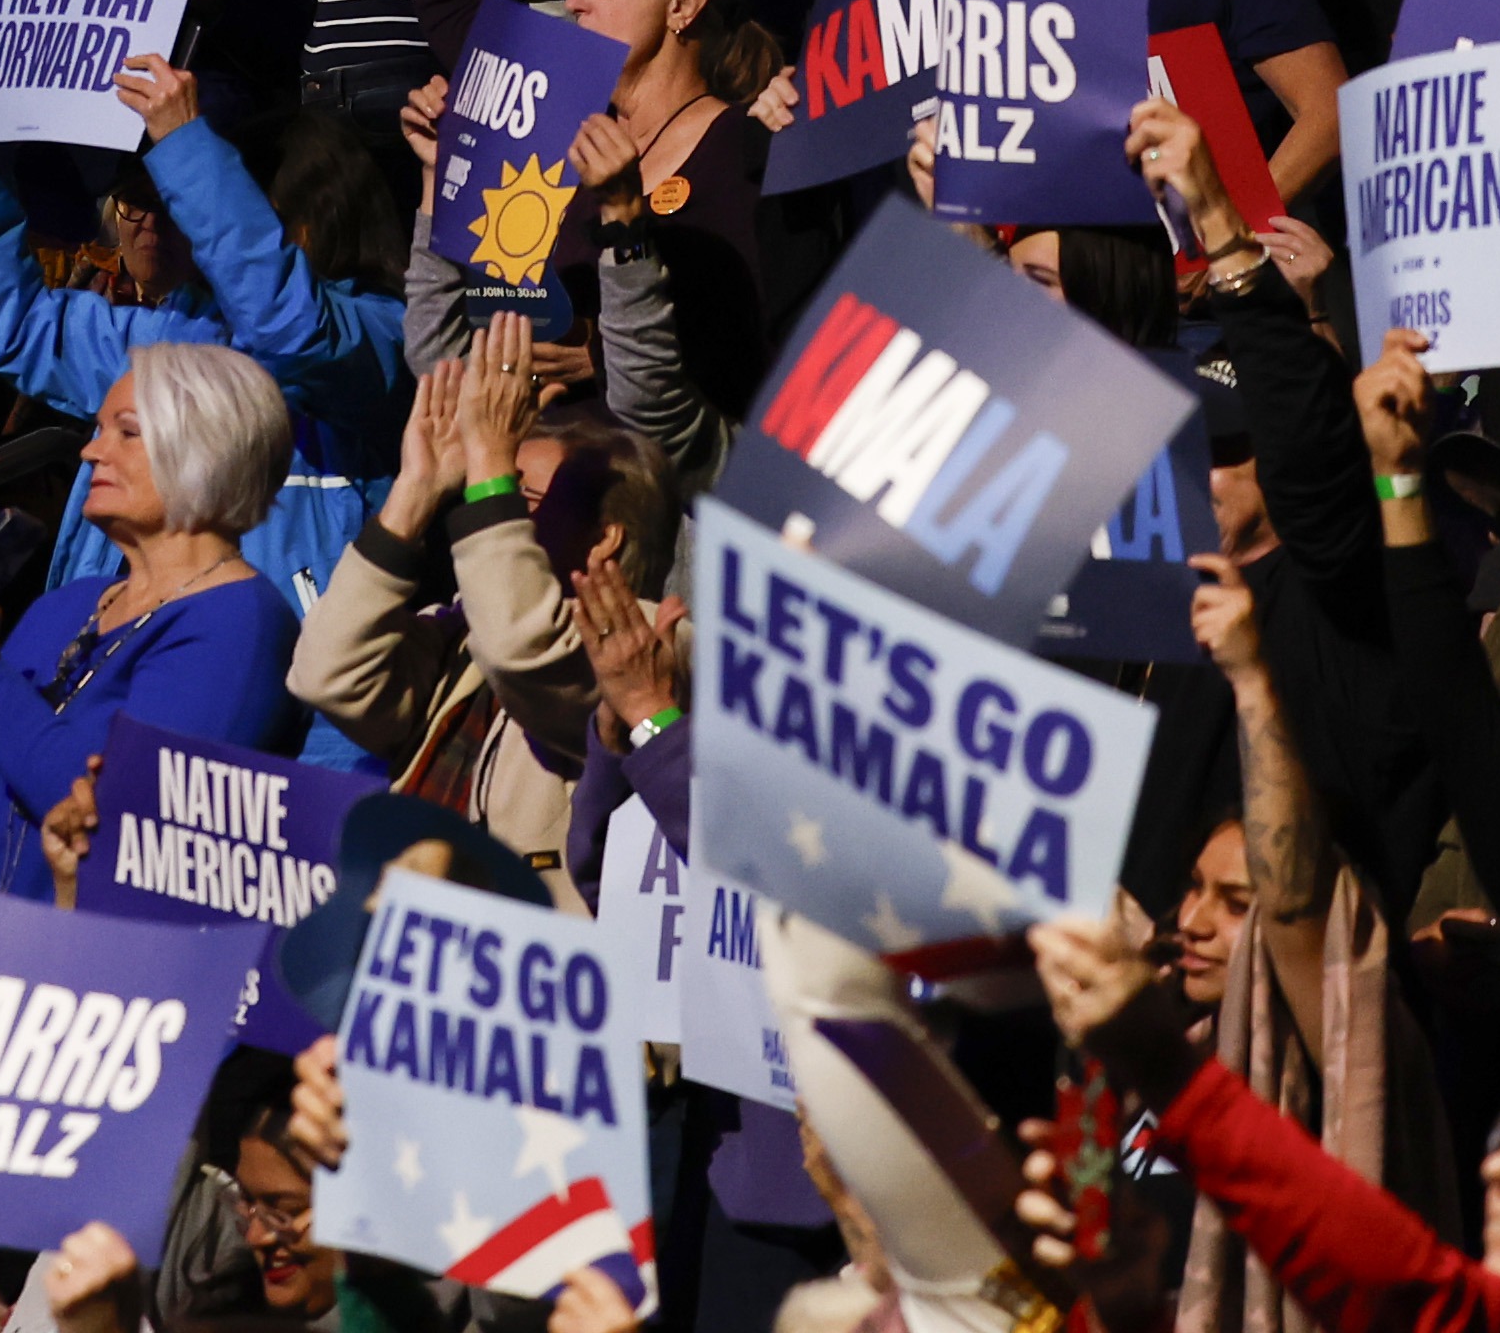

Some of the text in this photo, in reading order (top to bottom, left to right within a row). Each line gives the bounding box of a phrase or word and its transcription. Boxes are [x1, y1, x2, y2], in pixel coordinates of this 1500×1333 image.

[453, 48, 548, 139] LATINOS
[1373, 70, 1486, 163] NATIVE
[482, 287, 504, 298] JOIN
[721, 547, 1093, 797] LET'S GO
[157, 747, 289, 848] NATIVE
[718, 641, 1070, 902] KAMALA
[112, 812, 338, 930] AMERICANS
[367, 904, 609, 1032] LET'S GO
[342, 990, 618, 1126] KAMALA
